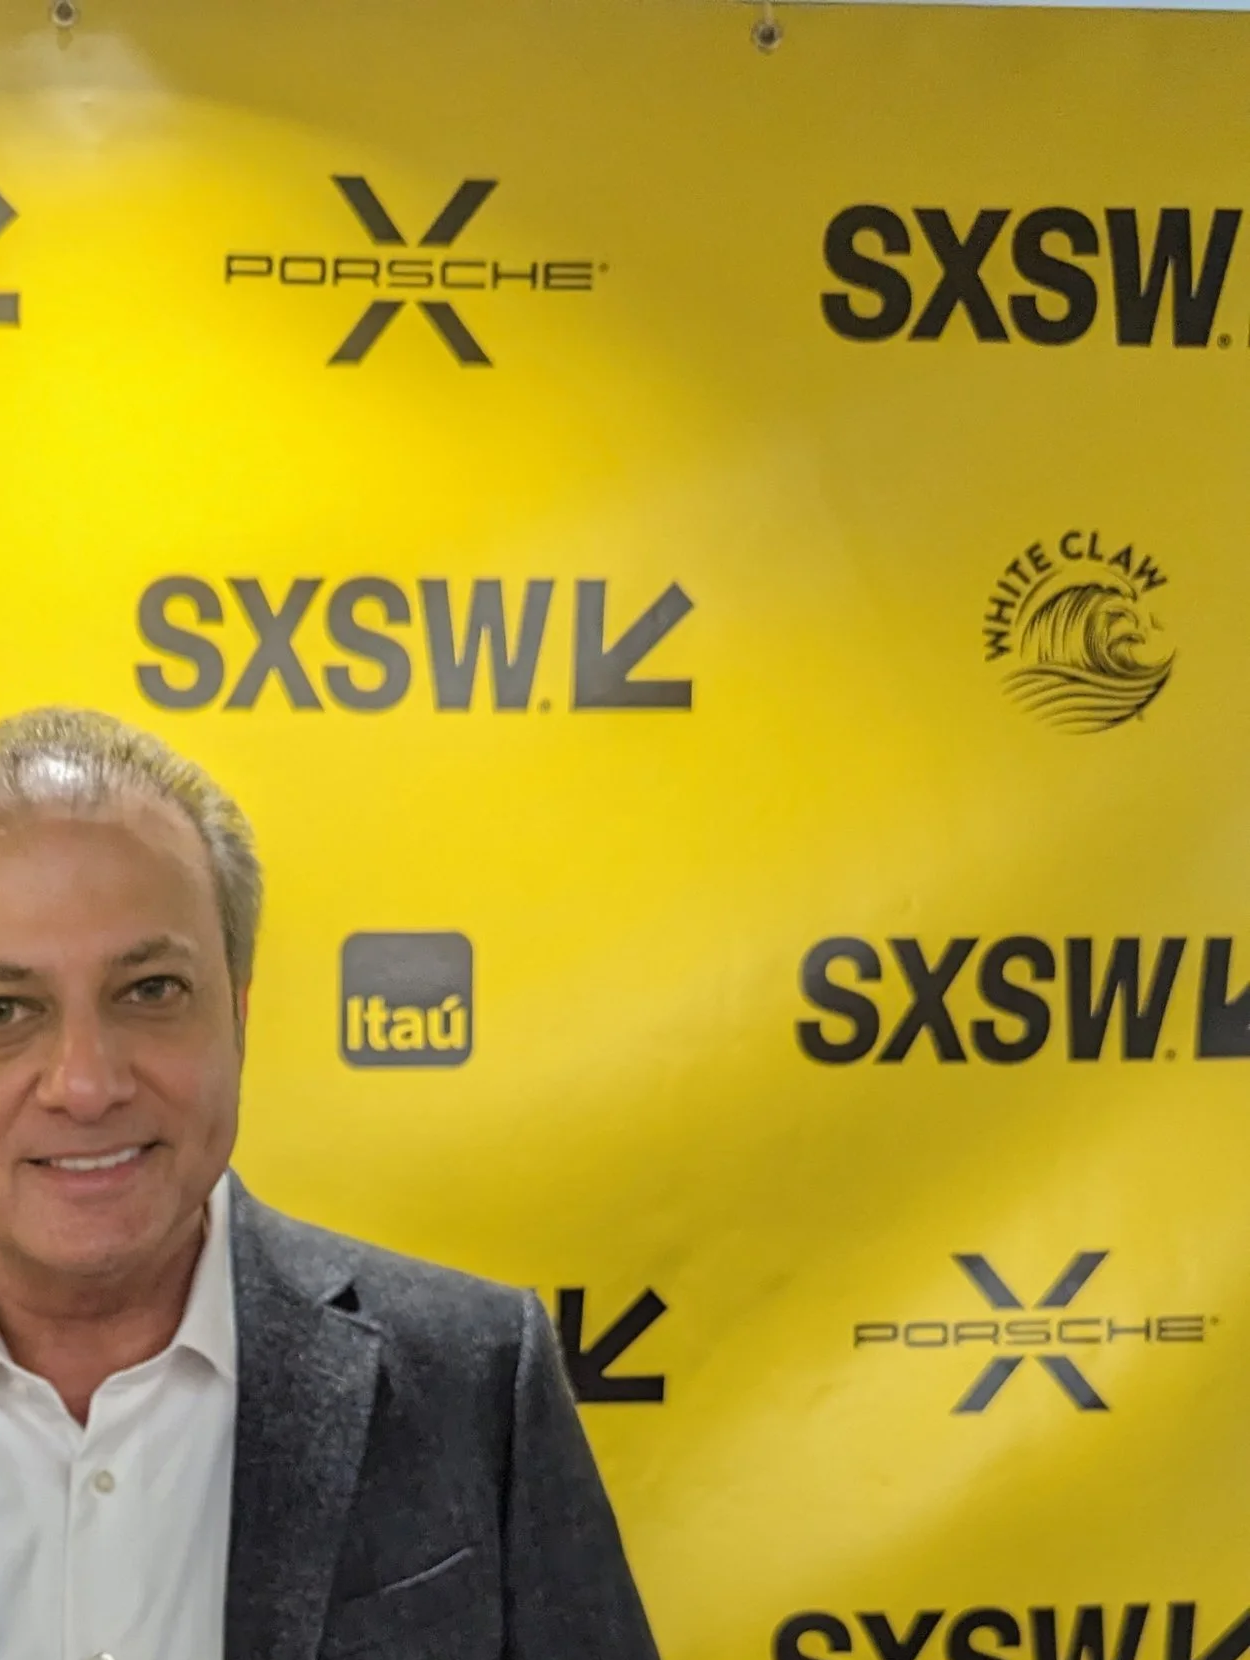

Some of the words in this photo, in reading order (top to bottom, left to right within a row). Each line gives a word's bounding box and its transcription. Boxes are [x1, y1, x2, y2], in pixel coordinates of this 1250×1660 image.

[225, 254, 593, 291] PORSCHE
[820, 204, 1243, 347] SXSW
[135, 576, 555, 713] SXSW
[982, 542, 1052, 663] WHITE
[1059, 529, 1168, 593] CLAW
[347, 994, 466, 1051] Itaú
[796, 935, 1188, 1065] SXSW
[853, 1315, 1204, 1349] PORSCHE
